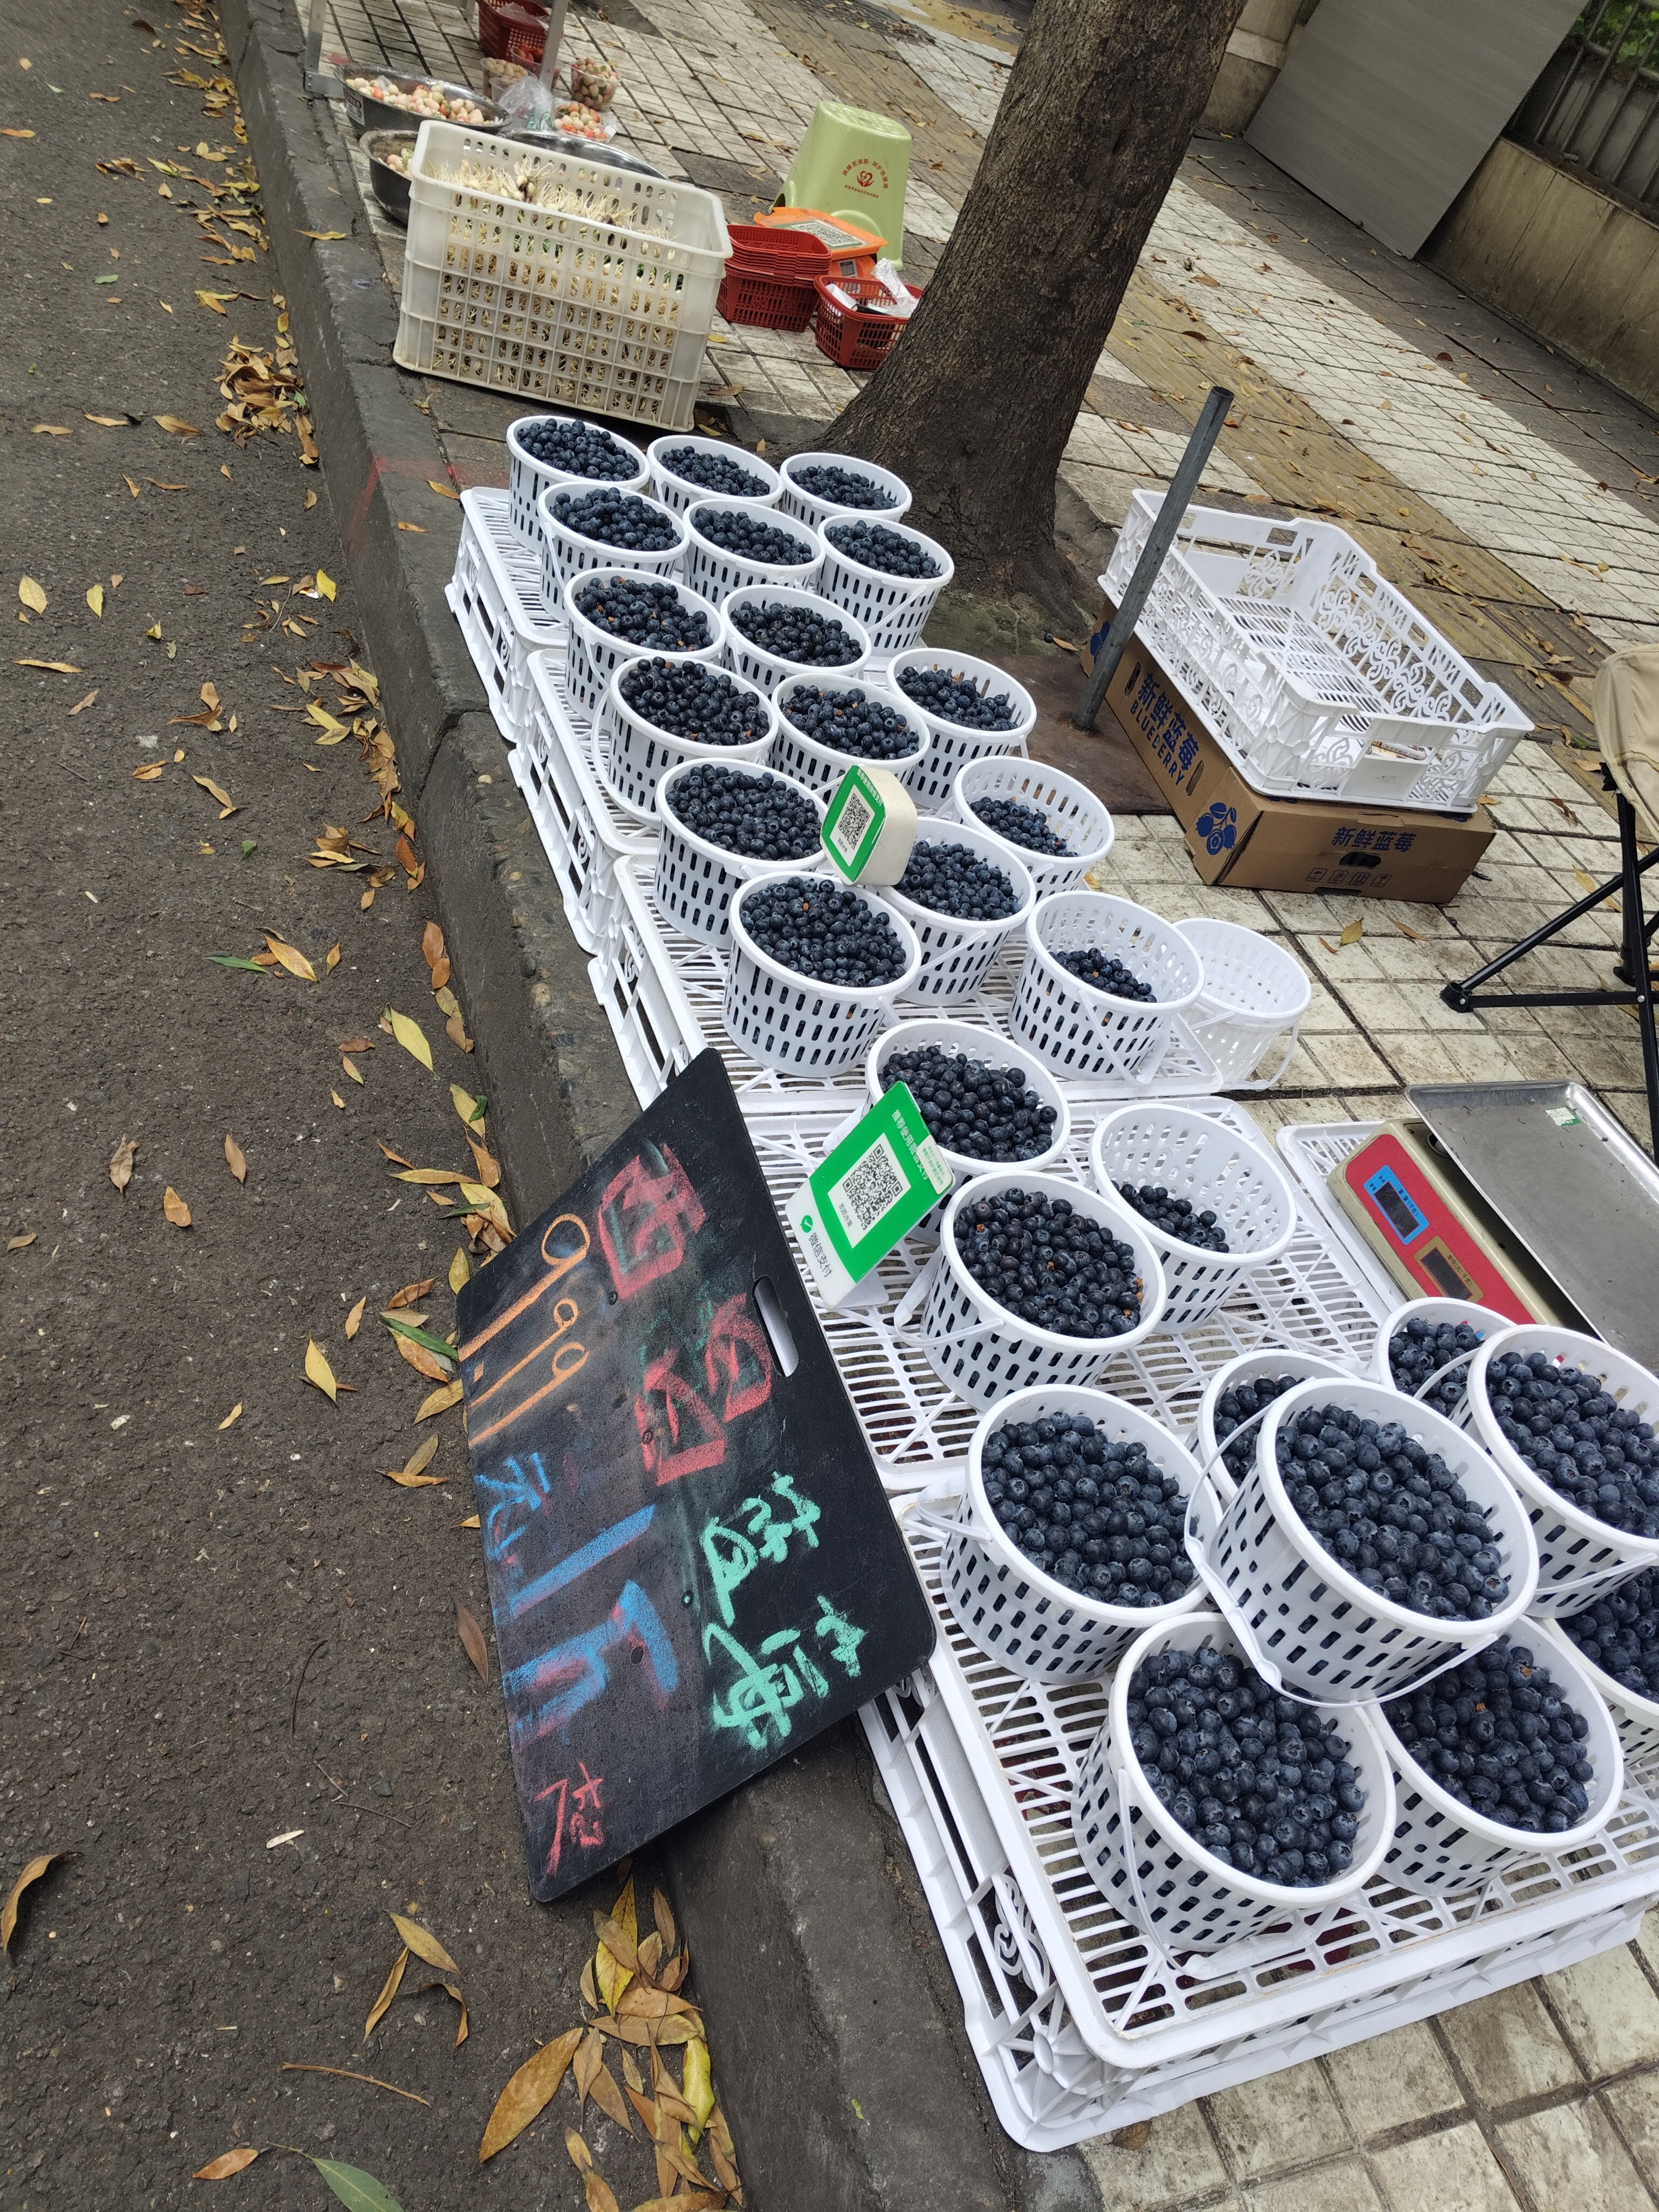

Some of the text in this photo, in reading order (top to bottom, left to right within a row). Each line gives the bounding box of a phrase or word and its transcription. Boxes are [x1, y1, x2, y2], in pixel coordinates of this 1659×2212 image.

[1138, 672, 1200, 771] 新鲜蓝莓
[1331, 826, 1417, 853] 新鲜蓝莓
[808, 1232, 833, 1278] 微信支付
